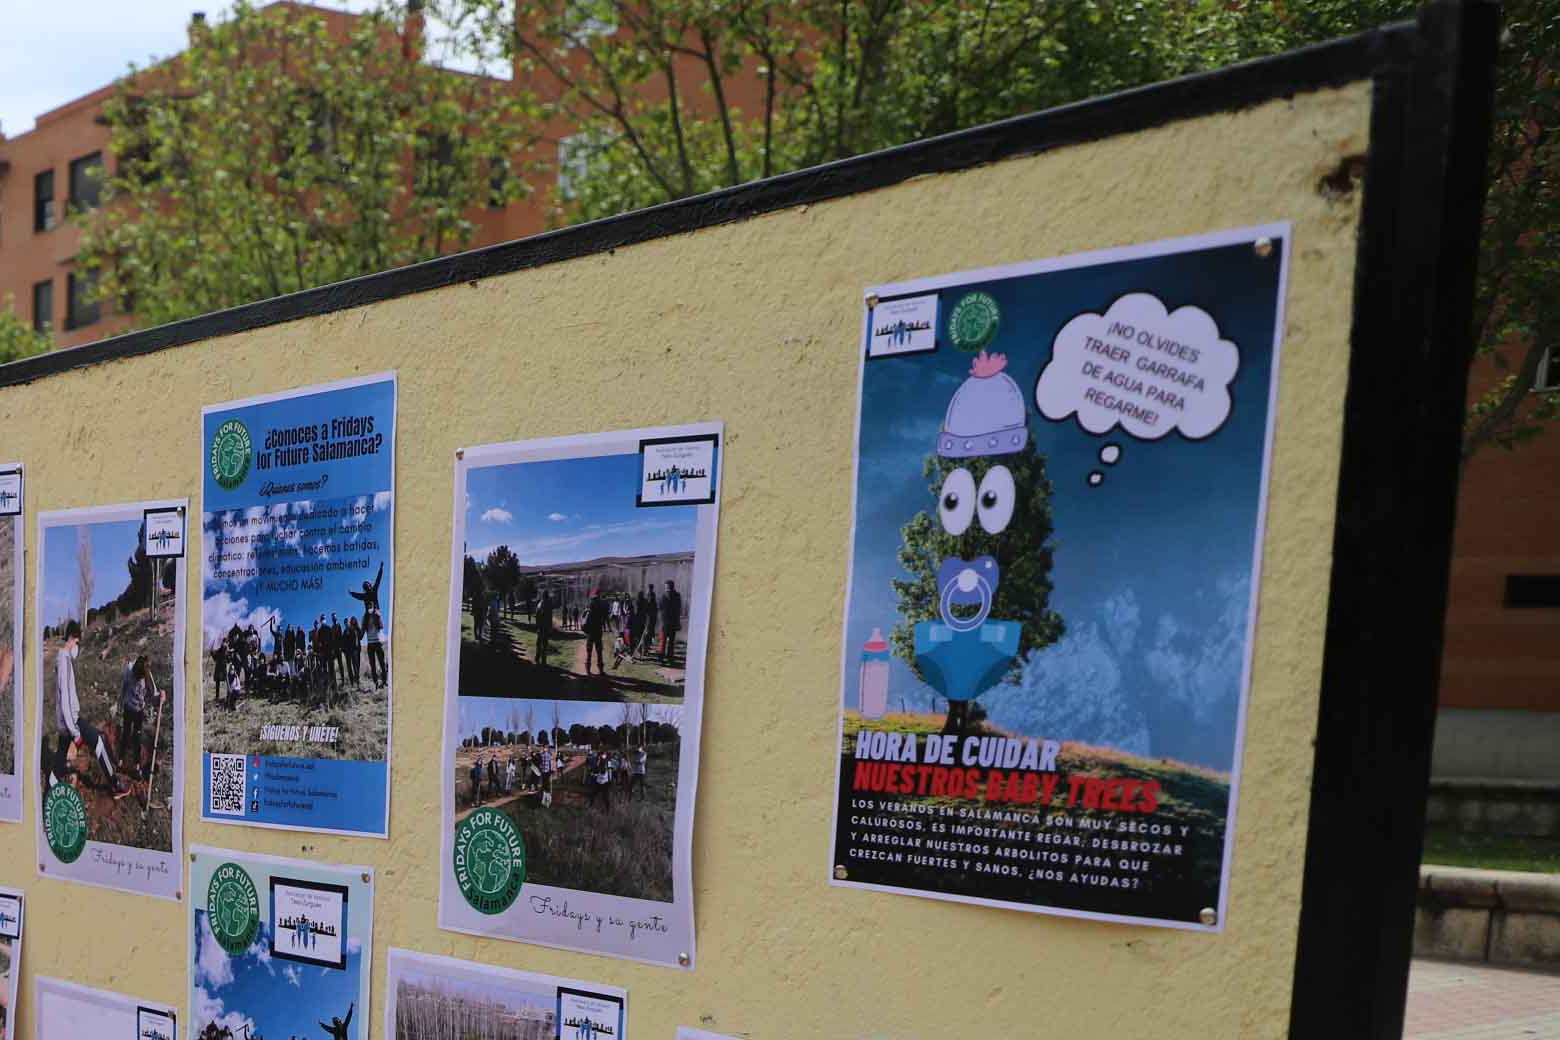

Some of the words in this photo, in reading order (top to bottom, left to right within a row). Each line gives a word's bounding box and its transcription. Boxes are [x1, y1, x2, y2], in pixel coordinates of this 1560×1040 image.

[960, 295, 976, 306] FOR
[1107, 322, 1134, 340] ¡NO
[1136, 329, 1201, 363] OLVIDES
[1084, 337, 1129, 362] TRAER
[1136, 357, 1206, 391] GARRAFA
[1082, 362, 1101, 379] DE
[1104, 371, 1143, 396] AGUA
[1146, 384, 1185, 410] PARA
[1085, 388, 1158, 425] REGARME!
[212, 436, 220, 480] FRIDAYS
[220, 422, 233, 435] FOR
[234, 423, 251, 455] FUTURE
[265, 424, 317, 449] ¿Conoces
[321, 427, 328, 440] a
[332, 416, 374, 439] Fridays
[275, 446, 308, 467] Future
[312, 434, 382, 462] Salamanca?
[302, 725, 308, 741] Y
[855, 730, 917, 763] HORA
[924, 735, 958, 765] DE
[962, 737, 1060, 772] CUIDAR
[52, 787, 66, 799] FOR
[68, 790, 86, 829] FUTURE
[853, 762, 978, 799] NUESTROS
[985, 772, 1060, 806] BABY
[1067, 776, 1161, 813] TREES
[851, 816, 926, 831] CALUROSOS,
[952, 825, 1030, 841] IMPORTANTE
[1037, 833, 1085, 847] REGAR,
[1092, 839, 1183, 855] DESBROZAR
[852, 800, 874, 809] LOS
[880, 802, 934, 814] VERANOS
[940, 807, 953, 816] EN
[960, 808, 1039, 824] SALAMANCA
[1046, 815, 1073, 827] SON
[1080, 818, 1112, 830] MUY
[1118, 821, 1172, 835] SECOS
[1180, 826, 1189, 836] Y
[456, 825, 472, 891] FRIDAYS
[470, 813, 492, 829] FOR
[493, 815, 522, 867] FUTURE
[850, 849, 902, 862] CREZCAN
[907, 855, 957, 868] FUERTES
[963, 861, 969, 869] Y
[1028, 869, 1063, 881] ¿NOS
[1070, 873, 1139, 888] AYUDAS?
[851, 832, 857, 840] Y
[863, 833, 921, 847] ARREGLAR
[926, 840, 990, 855] NUESTROS
[995, 847, 1068, 863] ARBOLITOS
[1075, 856, 1112, 867] PARA
[1119, 860, 1150, 871] QUE
[208, 878, 220, 935] FRIDAYS
[218, 867, 234, 879] FOR
[236, 869, 258, 915] FUTURE
[529, 895, 591, 930] Fridays
[596, 917, 603, 933] y
[629, 915, 668, 940] gente
